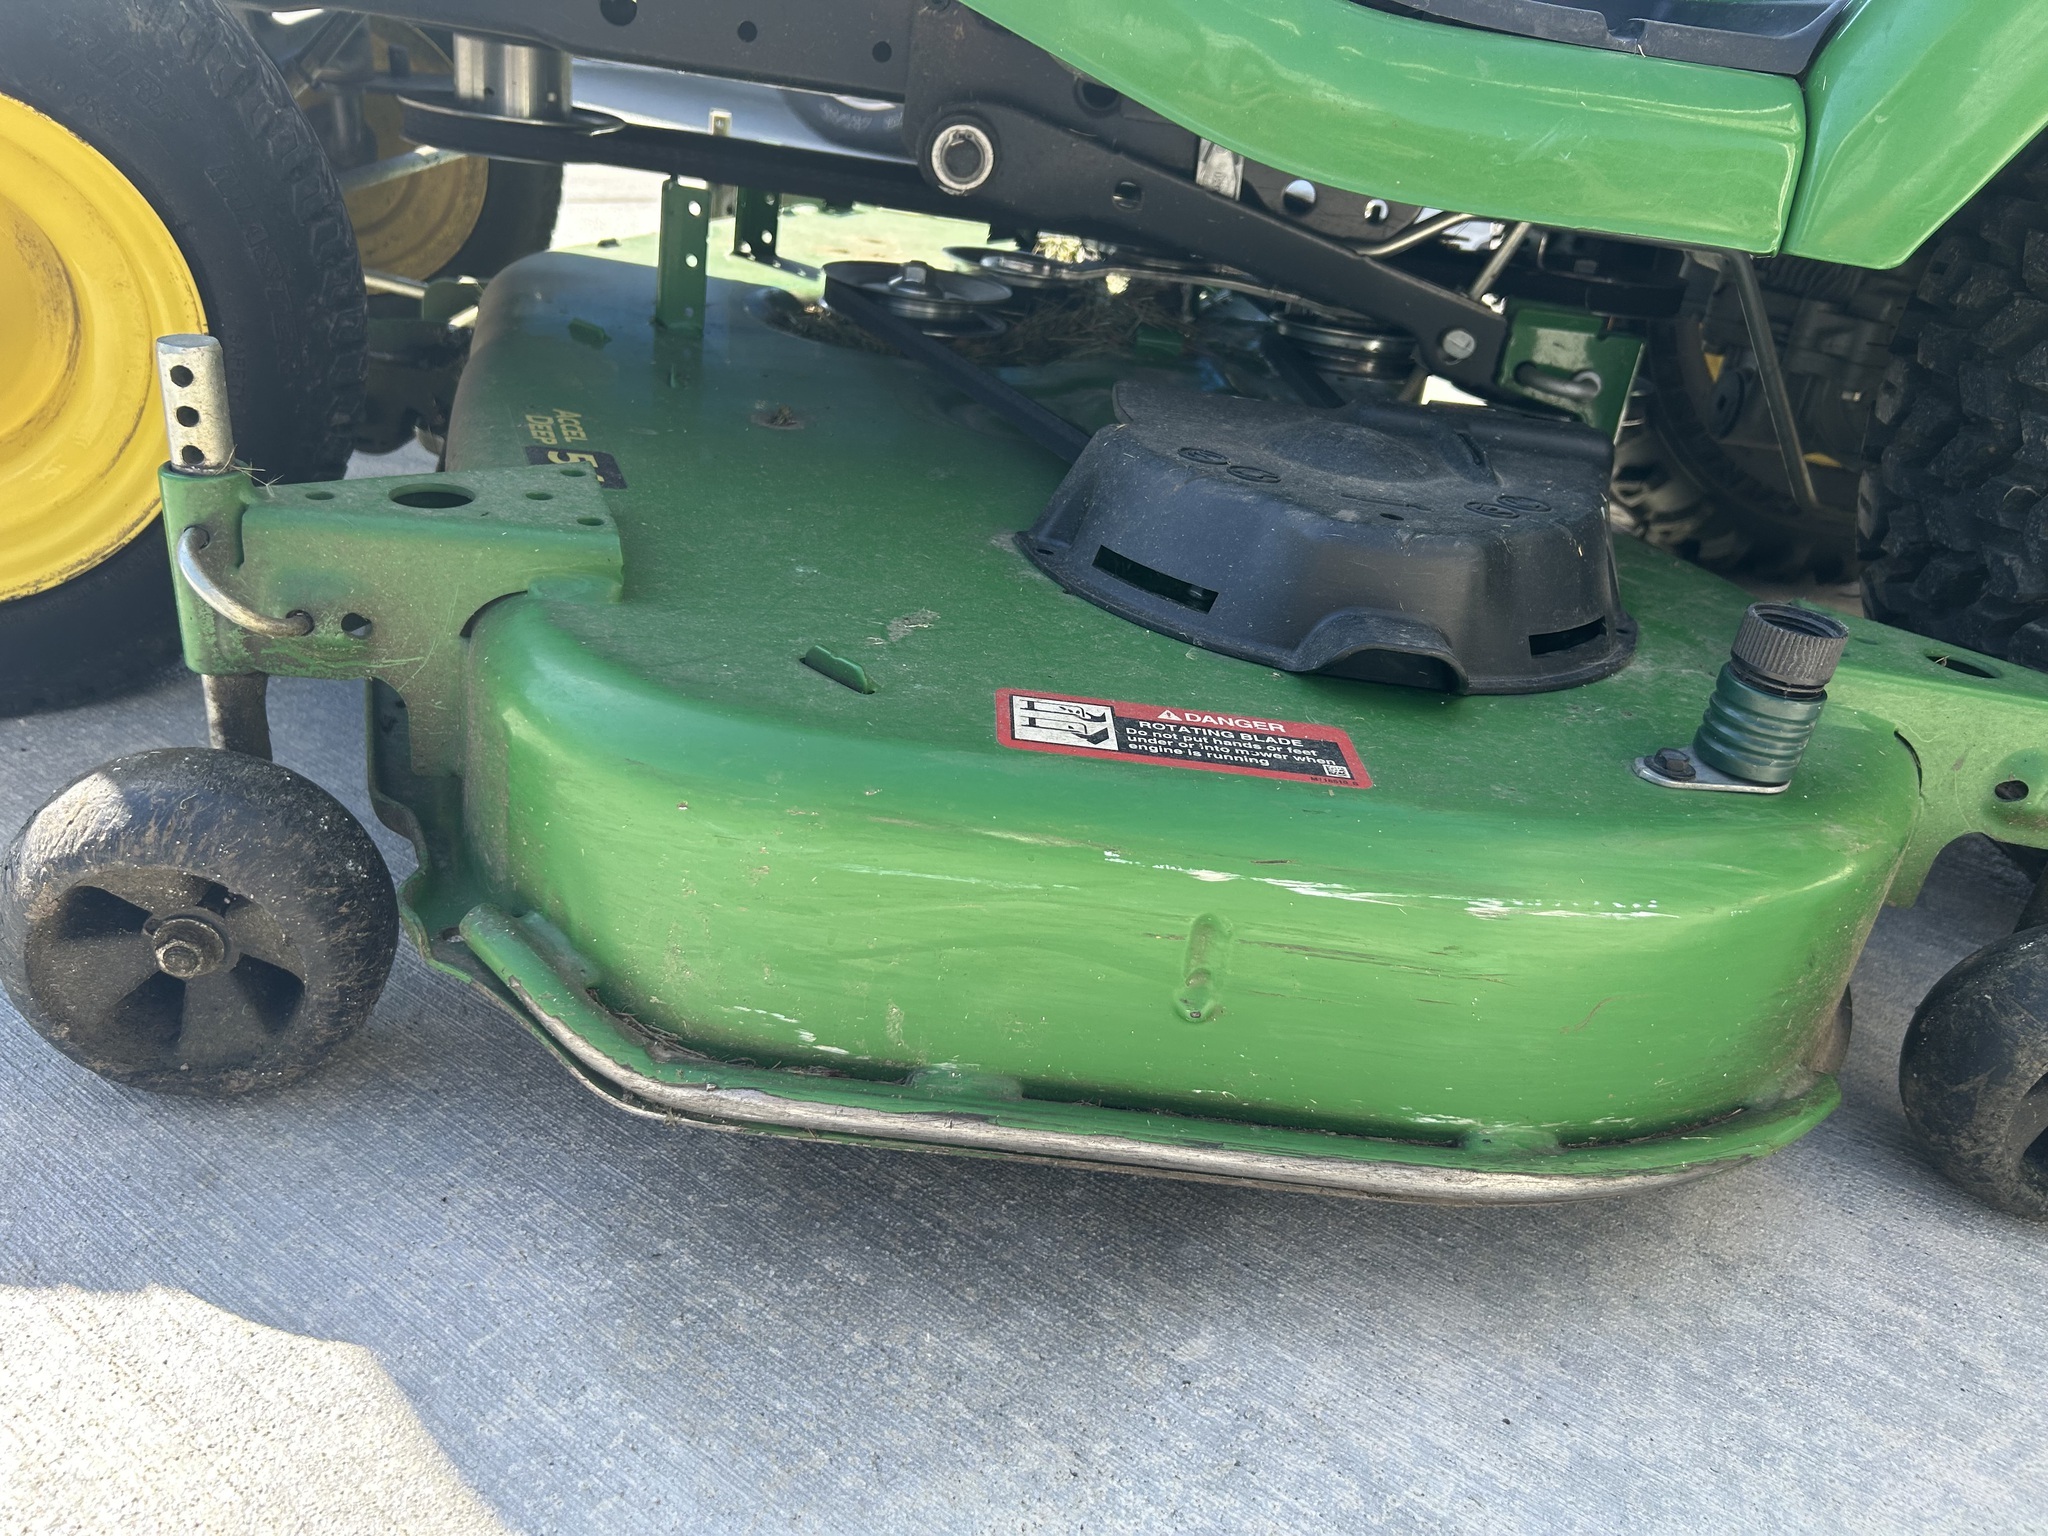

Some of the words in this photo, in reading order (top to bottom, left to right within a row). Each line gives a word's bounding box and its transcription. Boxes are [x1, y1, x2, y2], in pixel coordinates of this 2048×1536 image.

[525, 414, 558, 445] DEEP
[553, 408, 588, 442] ACCEL
[1139, 720, 1235, 739] ROTATING
[1239, 732, 1304, 747] BLADE
[1184, 712, 1286, 733] DANGER
[1125, 727, 1148, 736] Do
[1152, 731, 1179, 740] not
[1183, 734, 1208, 744] put
[1213, 736, 1262, 750] hands
[1266, 744, 1283, 752] or
[1286, 746, 1318, 757] feet
[1127, 735, 1174, 747] under
[1178, 741, 1195, 749] or
[1199, 742, 1230, 753] into
[1235, 748, 1289, 760] mower
[1292, 755, 1336, 766] when
[1128, 743, 1183, 755] engine
[1188, 748, 1202, 757] is
[1206, 752, 1270, 767] running
